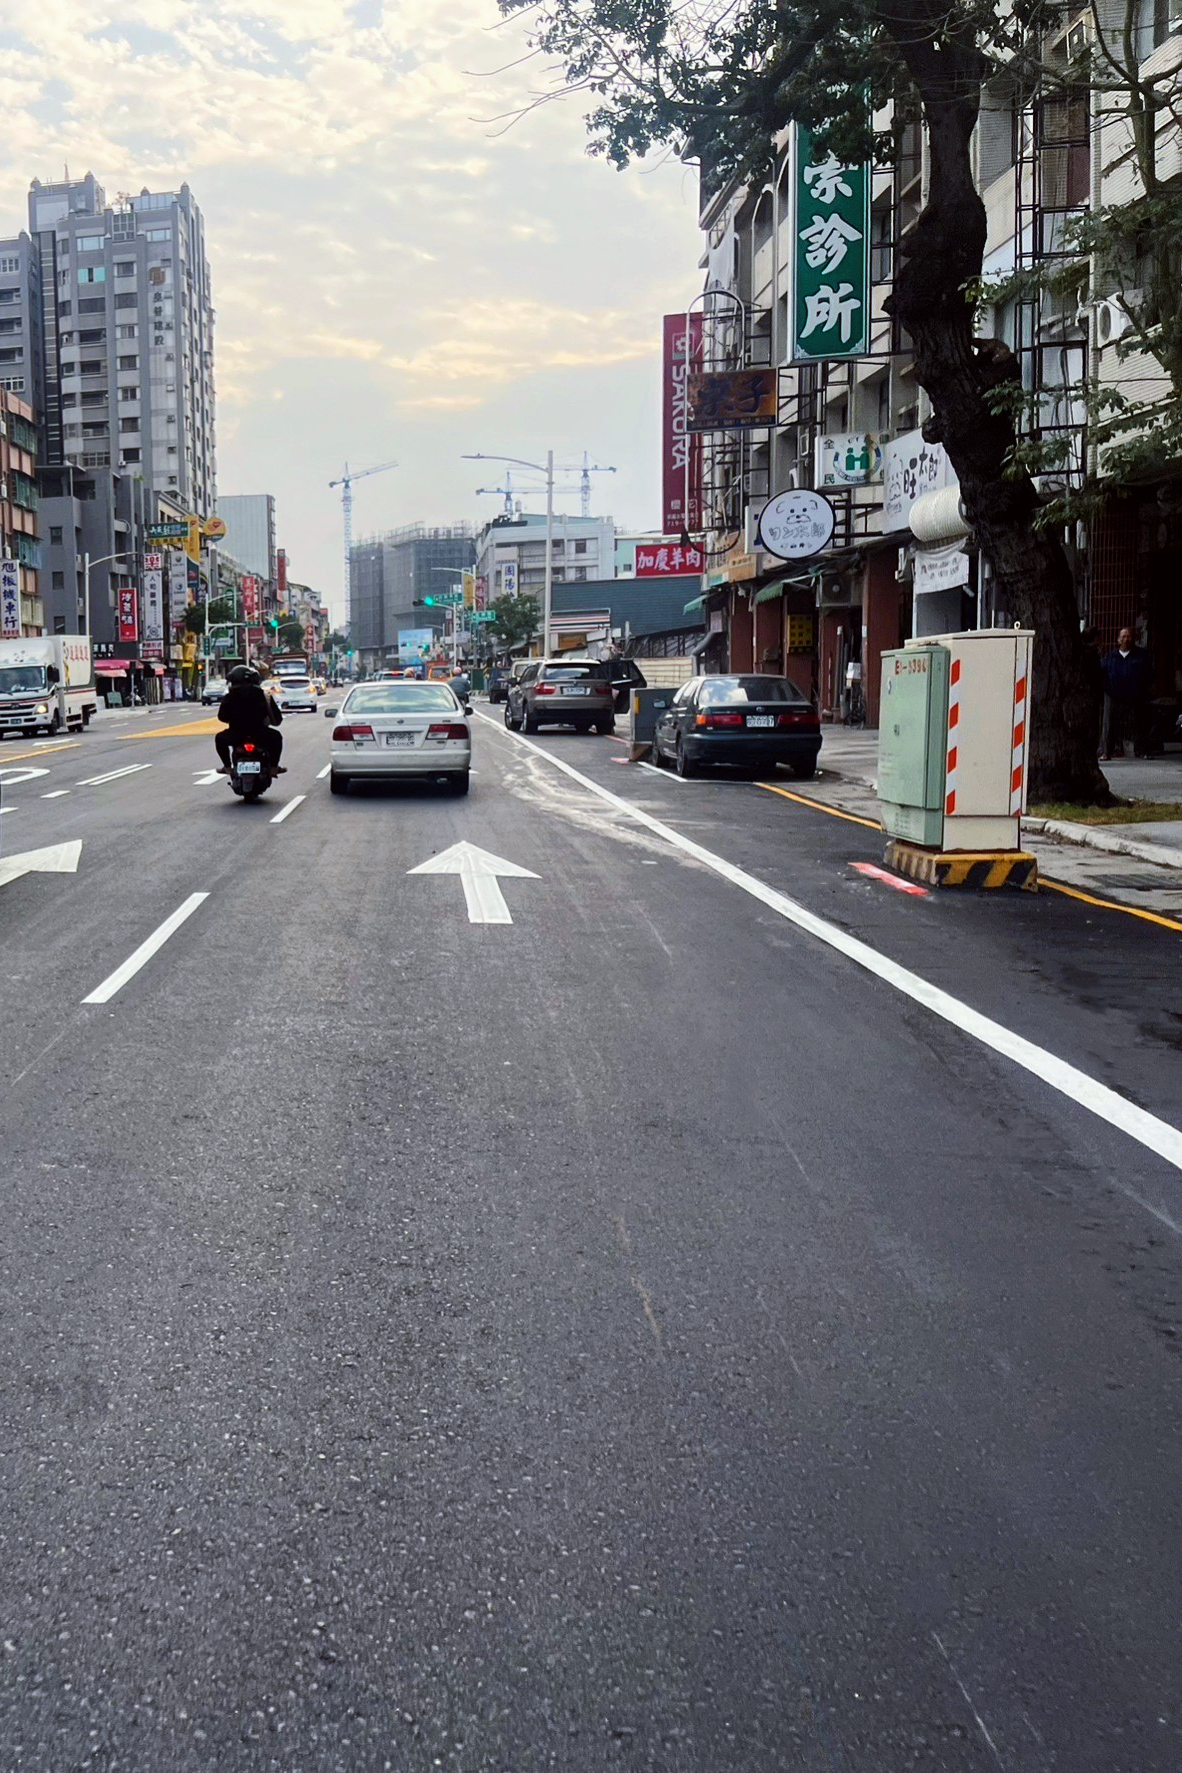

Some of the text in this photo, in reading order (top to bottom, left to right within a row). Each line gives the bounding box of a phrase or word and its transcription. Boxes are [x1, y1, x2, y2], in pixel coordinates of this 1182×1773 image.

[672, 365, 690, 470] SAKURA
[638, 547, 701, 570] 加慶羊肉
[2, 563, 17, 629] 旭振機車行
